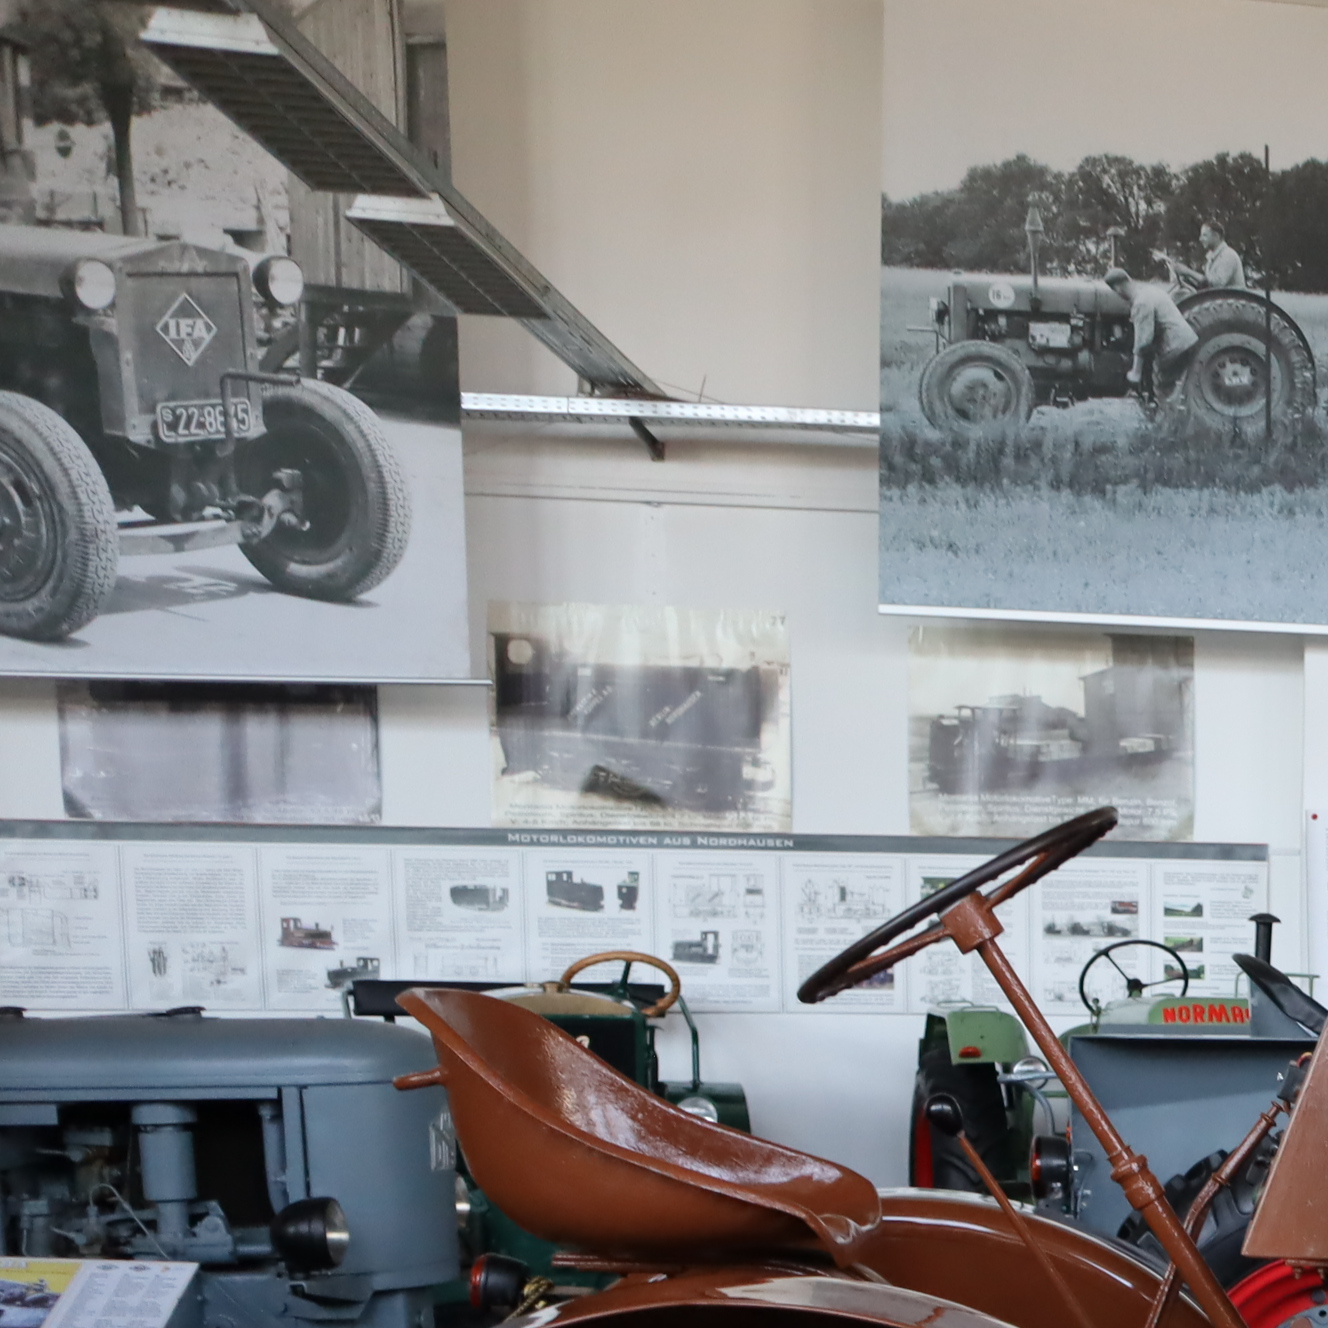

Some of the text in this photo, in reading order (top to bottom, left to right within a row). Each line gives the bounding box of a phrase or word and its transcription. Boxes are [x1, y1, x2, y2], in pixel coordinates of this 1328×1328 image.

[168, 318, 208, 340] IFA
[507, 832, 795, 848] MOTORLOKOMOTIVEN AUS NORDHAUSEN
[1162, 1003, 1251, 1025] NORMA
